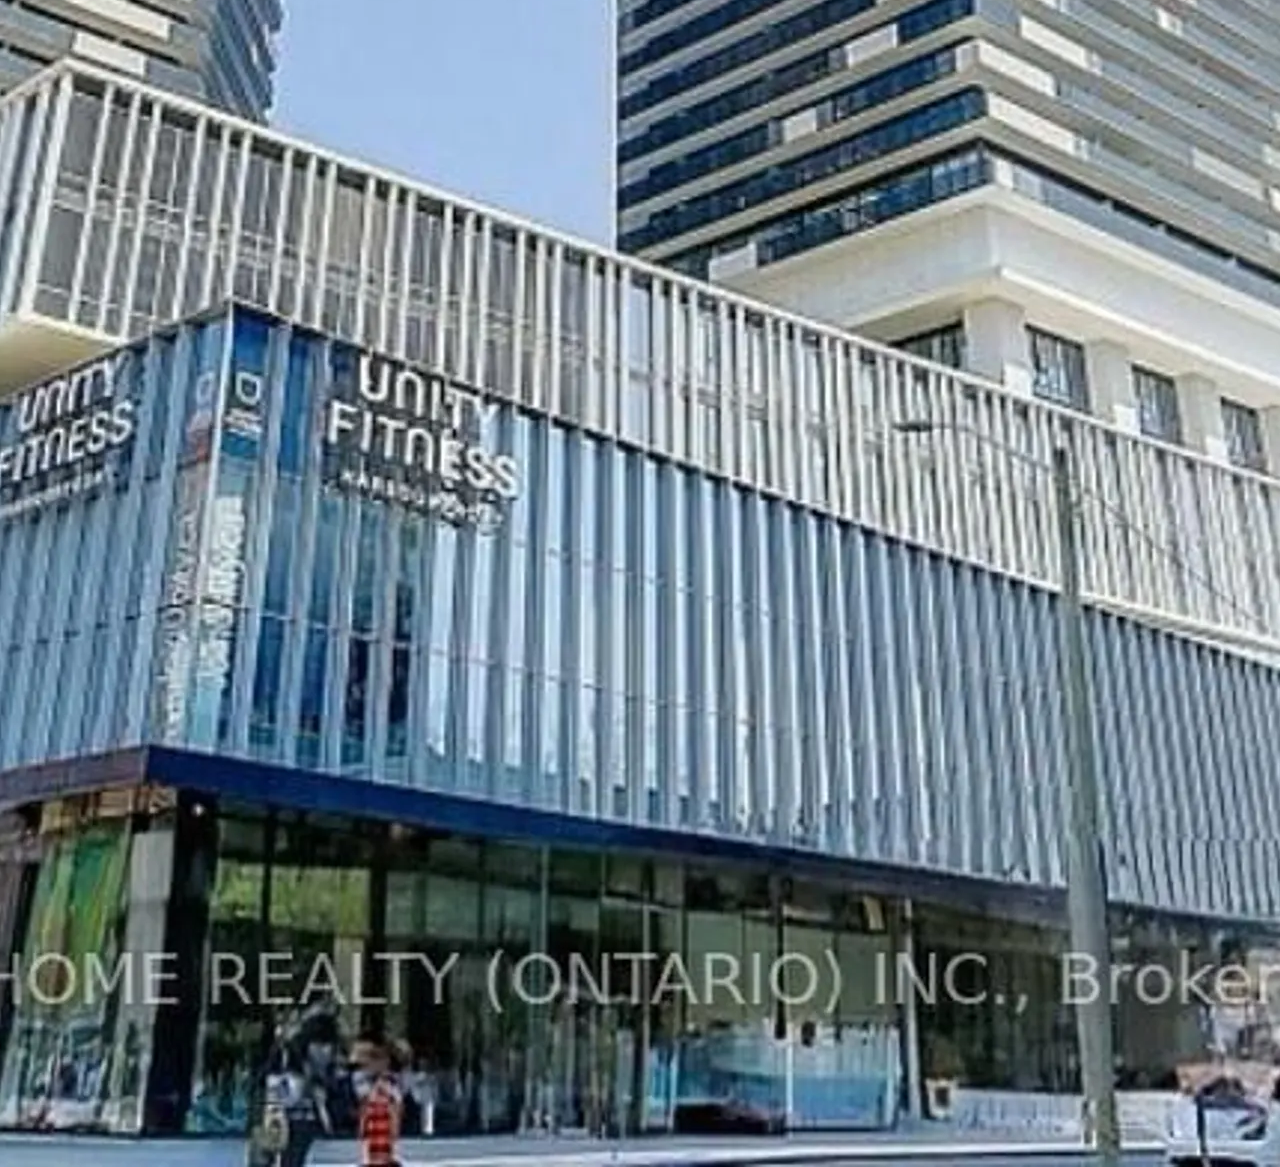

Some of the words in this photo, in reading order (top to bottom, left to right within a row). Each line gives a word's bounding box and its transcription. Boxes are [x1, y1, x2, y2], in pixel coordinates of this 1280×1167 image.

[18, 349, 133, 433] UNITY
[359, 355, 500, 437] UNITY
[328, 399, 519, 499] FITNESS
